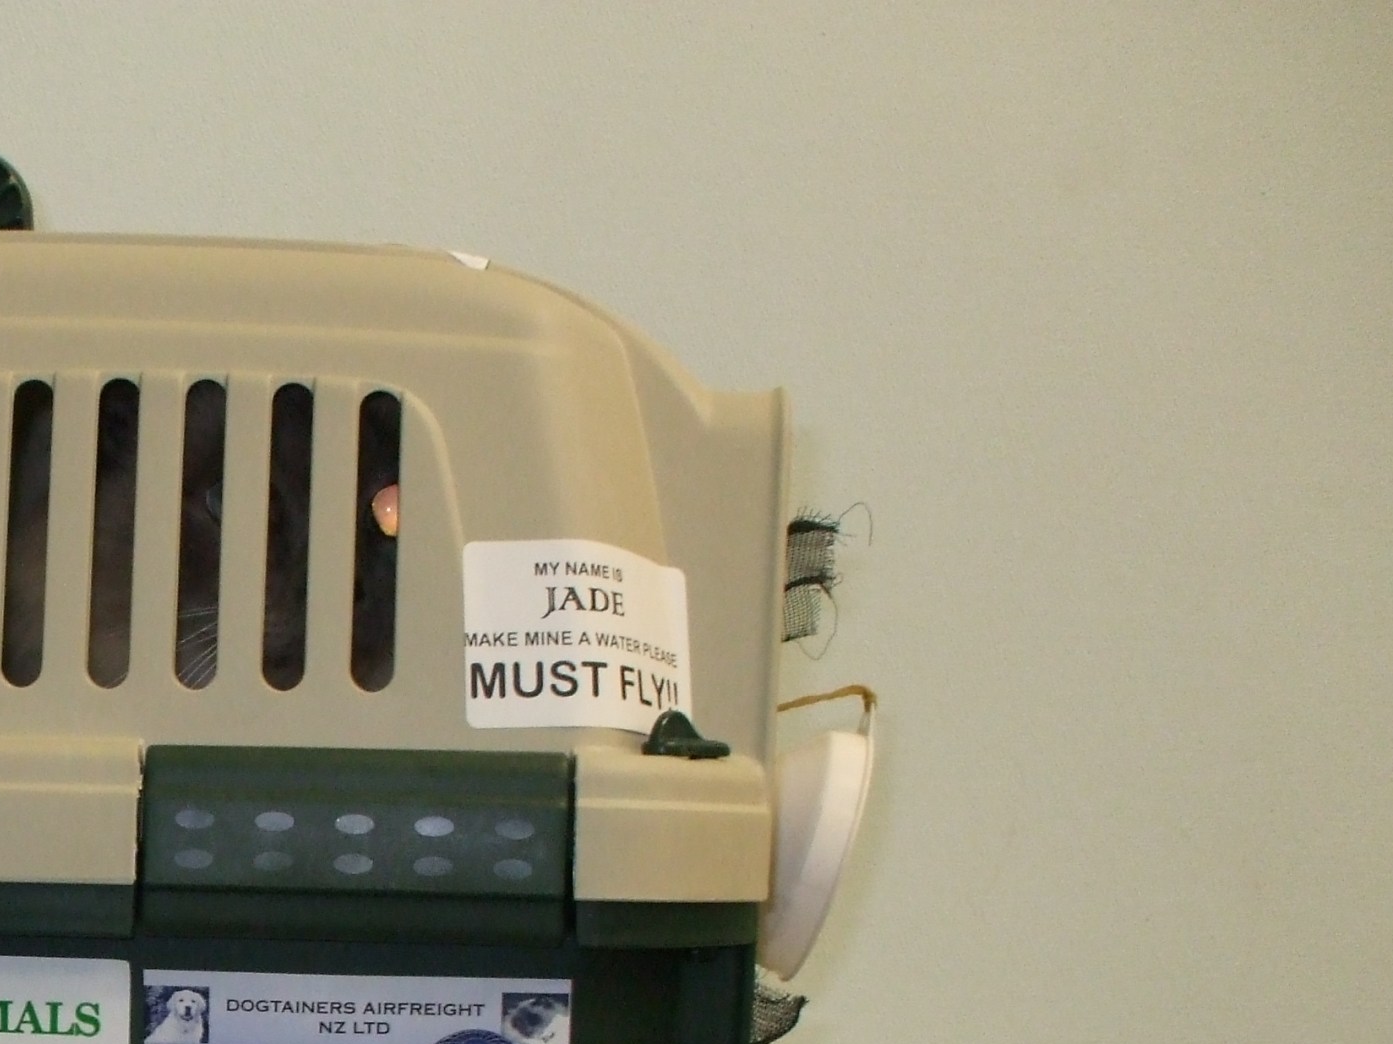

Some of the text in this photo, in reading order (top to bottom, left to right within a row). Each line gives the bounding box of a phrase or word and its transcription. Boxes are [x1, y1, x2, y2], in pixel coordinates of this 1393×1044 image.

[534, 562, 623, 582] MY NAME IS
[541, 586, 625, 619] JADE
[464, 631, 678, 668] MAKE MINE A WATER PLEASE
[470, 661, 679, 711] MUST FLY!!
[226, 999, 485, 1016] DOGTAINERS AIRFREIGHT
[318, 1022, 390, 1034] NZ LTD
